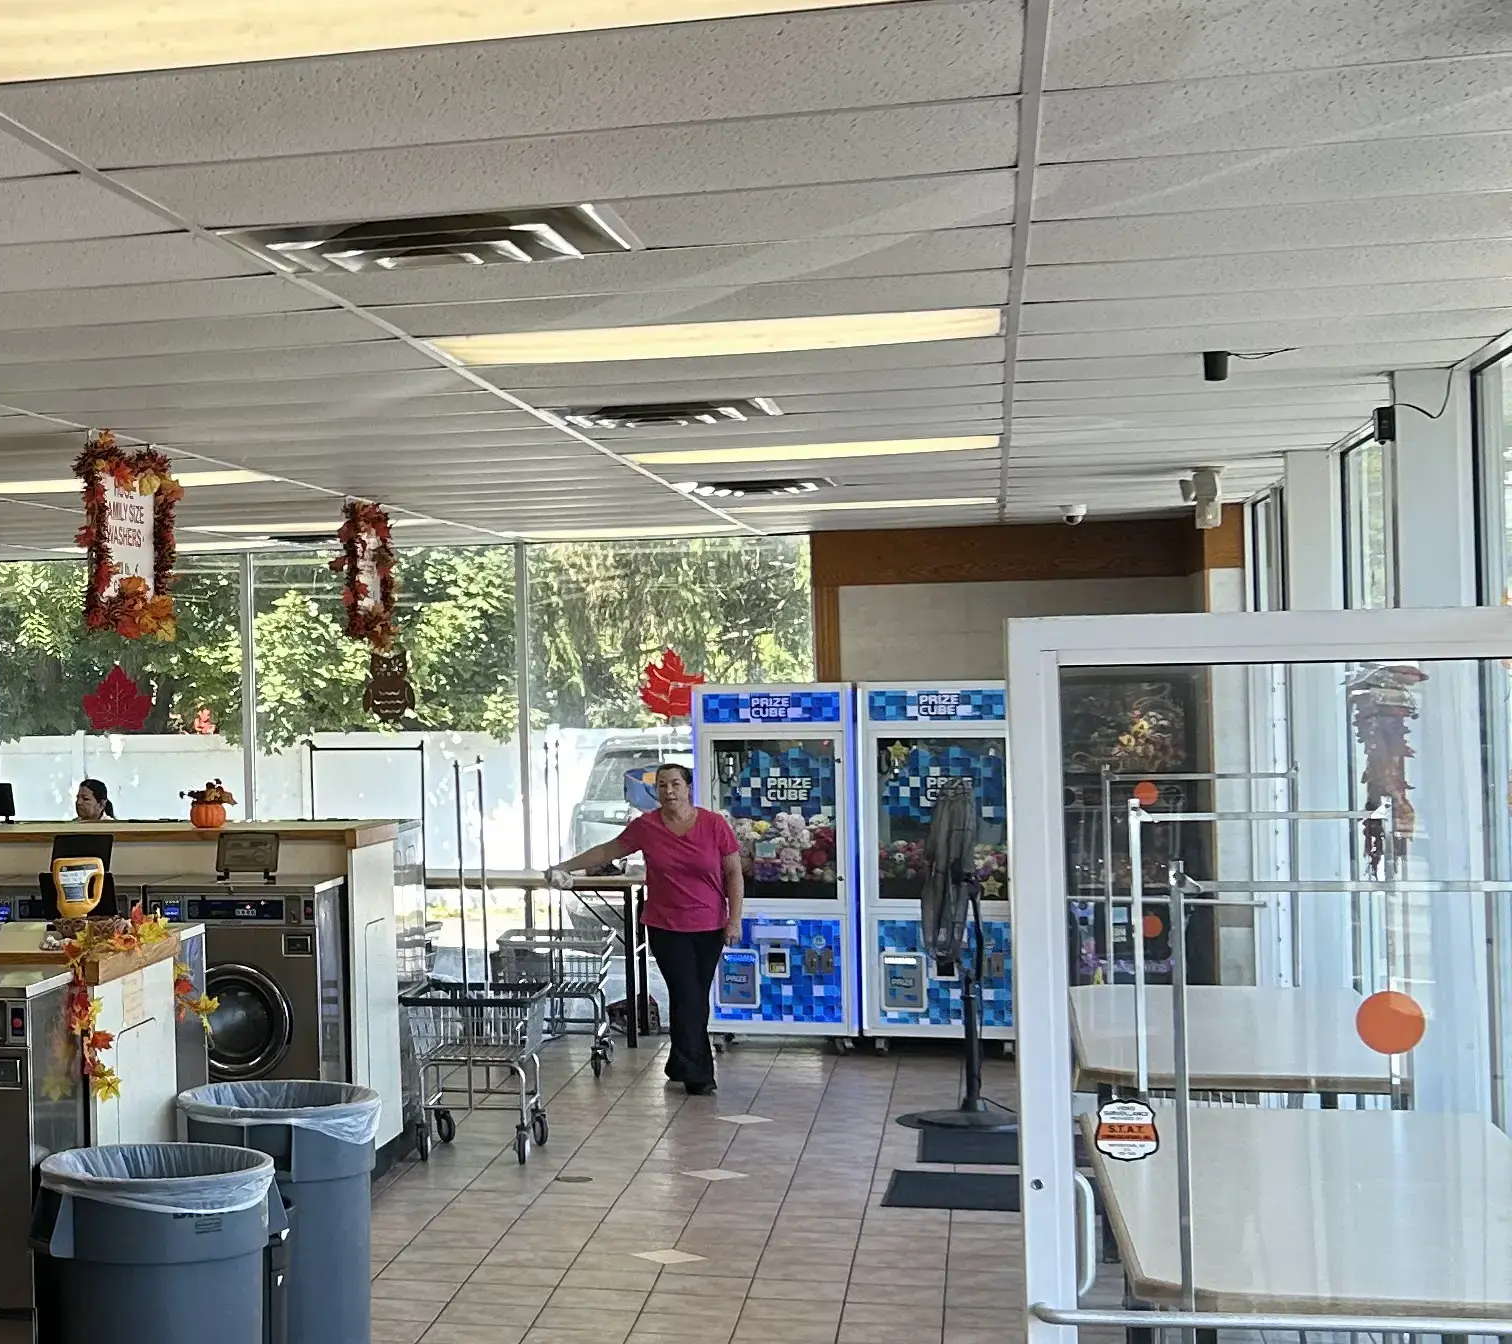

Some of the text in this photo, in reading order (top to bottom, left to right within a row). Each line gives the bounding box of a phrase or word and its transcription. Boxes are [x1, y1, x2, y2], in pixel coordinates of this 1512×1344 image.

[107, 501, 145, 524] AMILY SIZE
[751, 697, 789, 707] PRIZE
[919, 694, 959, 705] PRIZE
[751, 707, 787, 718] CUBE
[919, 705, 955, 715] CUBE
[767, 777, 812, 789] PRIZE
[767, 789, 808, 801] CUBE
